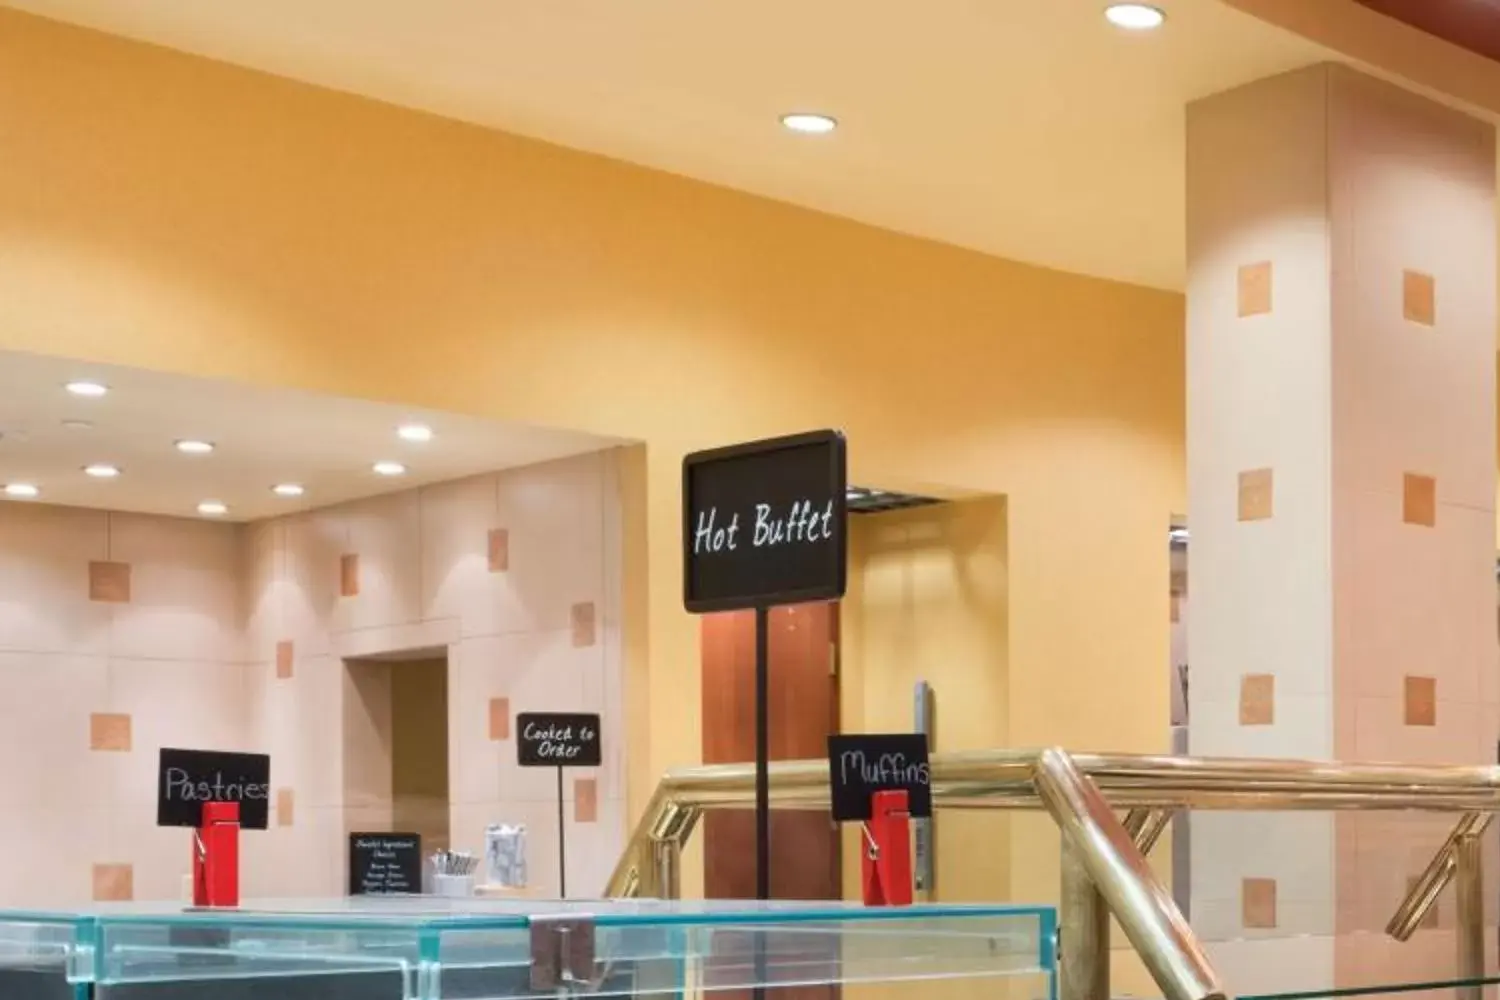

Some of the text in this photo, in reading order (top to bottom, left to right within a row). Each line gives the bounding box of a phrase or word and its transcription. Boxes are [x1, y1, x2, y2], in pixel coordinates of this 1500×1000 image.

[694, 499, 833, 554] Hot Buffet
[523, 721, 595, 741] Cooked to
[537, 740, 581, 757] Order
[165, 766, 270, 801] Pastries
[841, 750, 930, 785] Muffins
